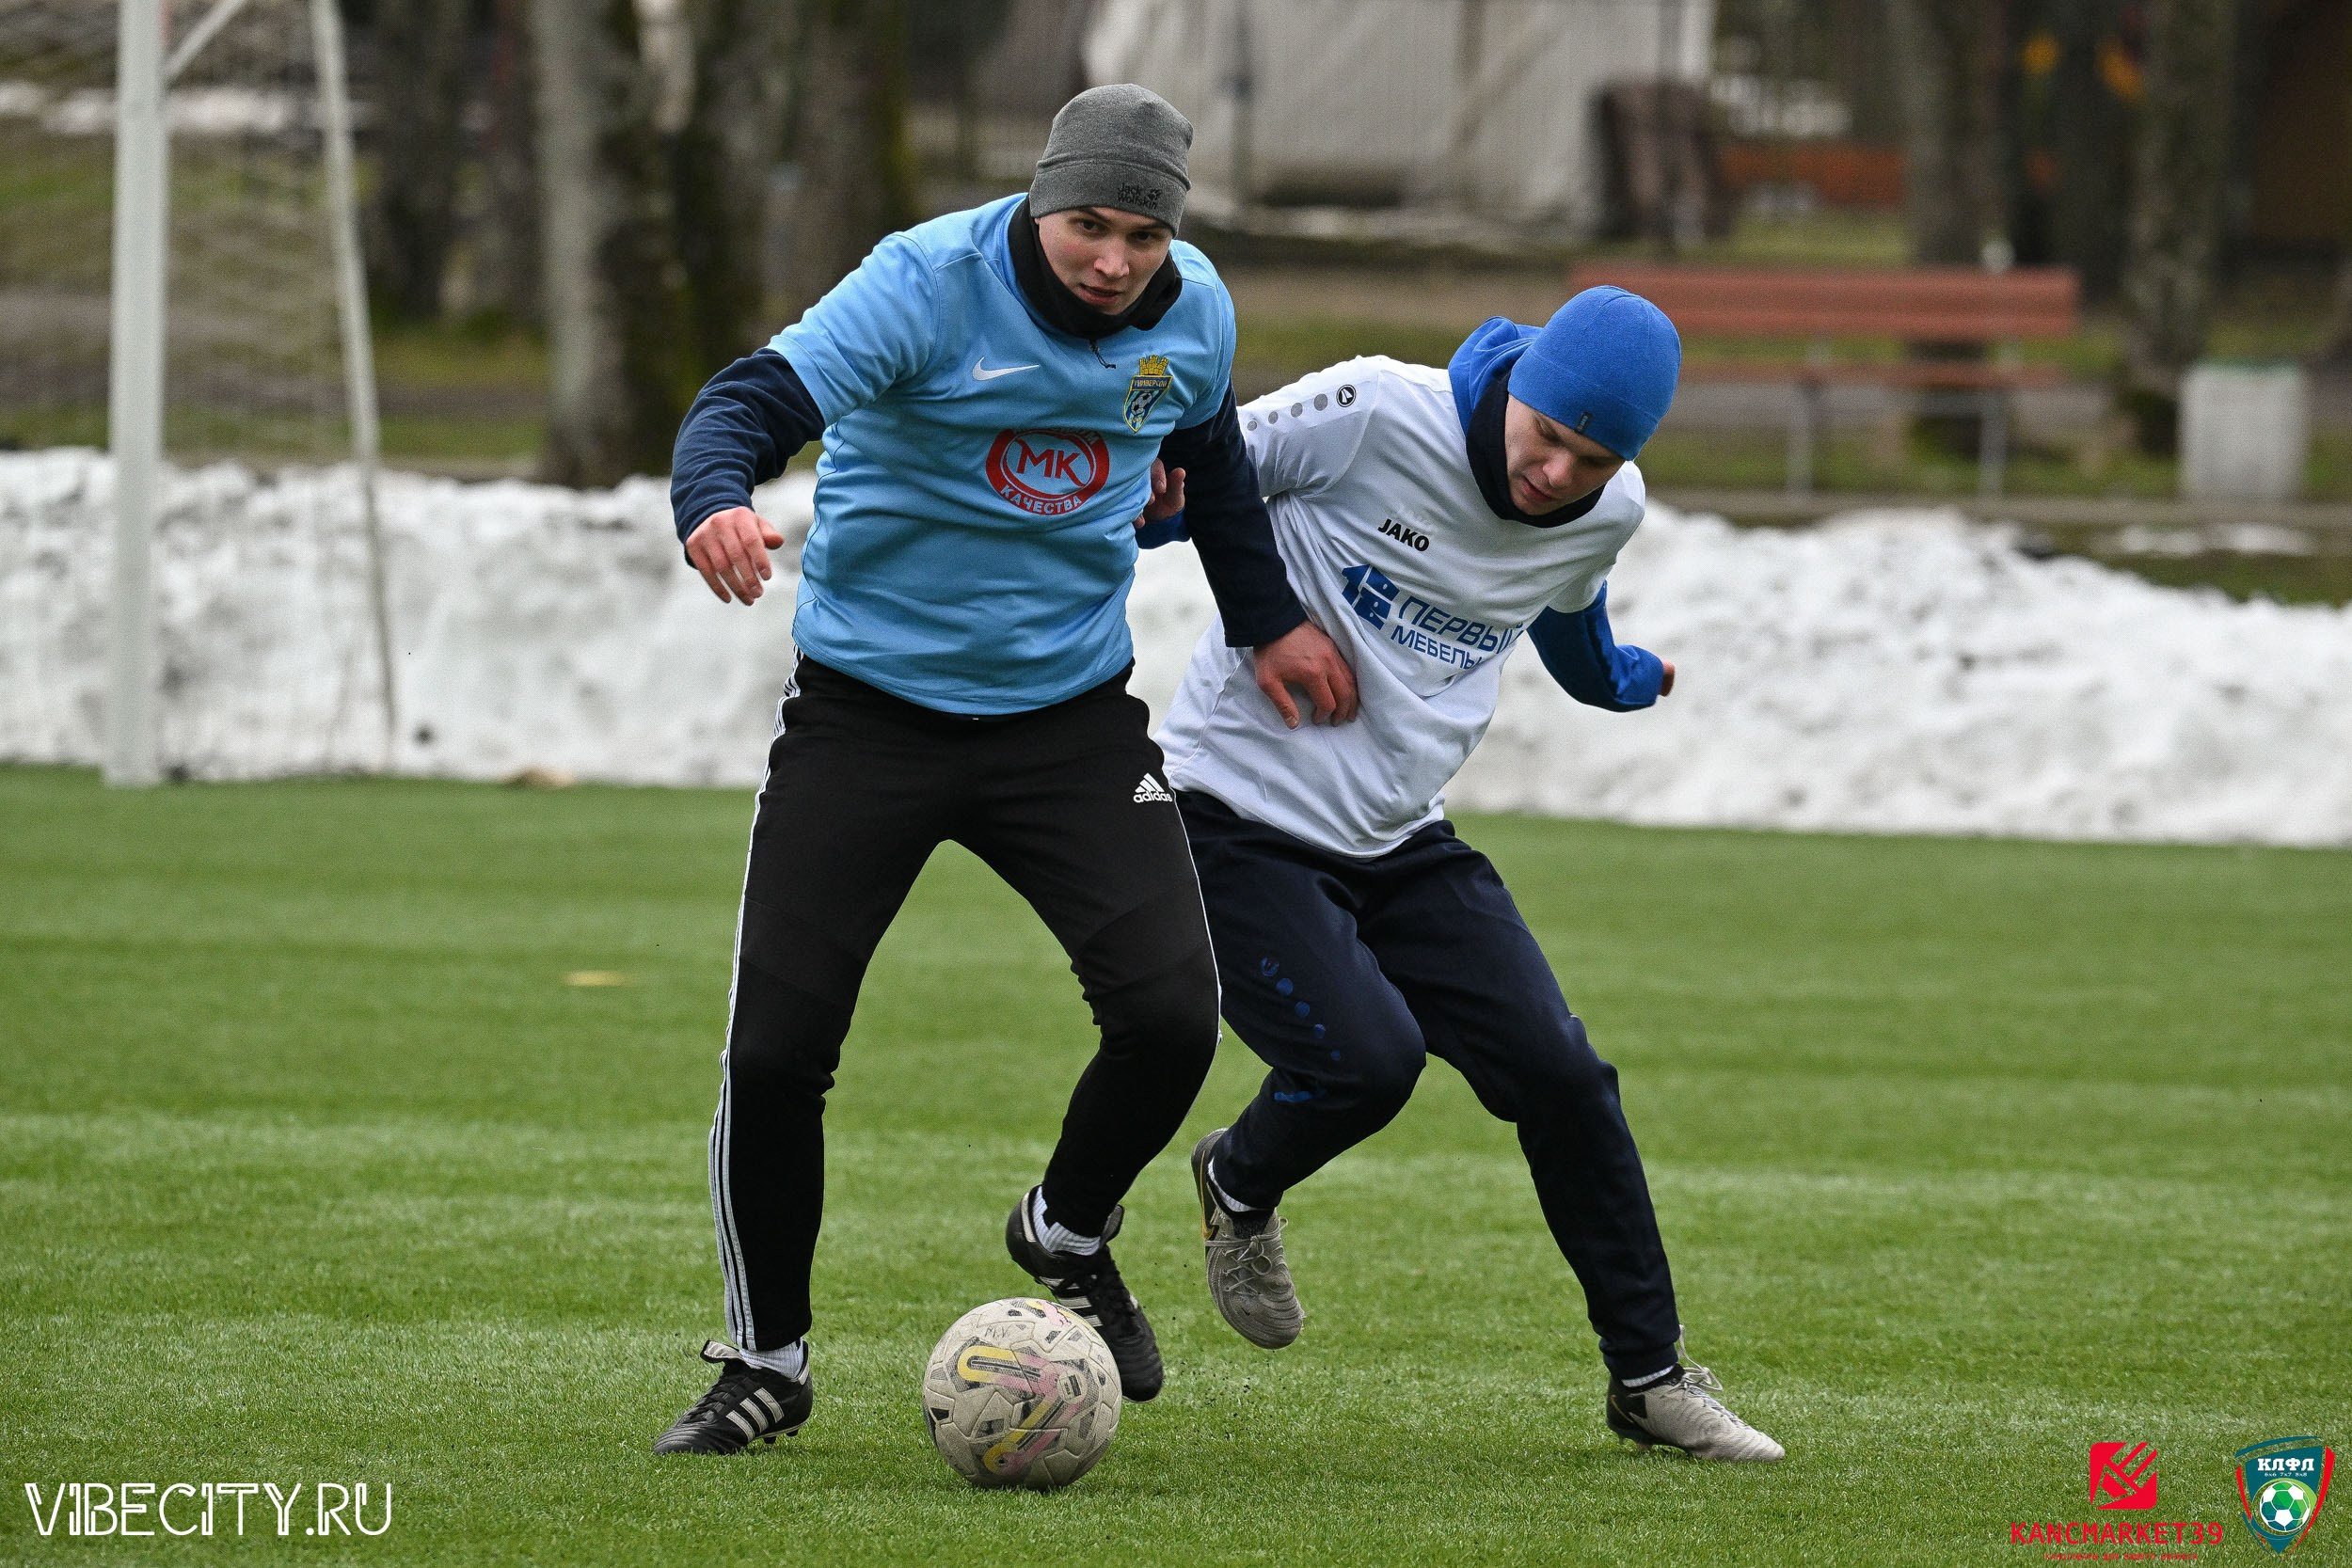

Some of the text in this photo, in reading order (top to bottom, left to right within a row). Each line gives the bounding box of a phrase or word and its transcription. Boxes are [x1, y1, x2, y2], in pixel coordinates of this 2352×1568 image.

[1118, 182, 1142, 195] Jack
[1117, 192, 1157, 210] Wolfskin
[1000, 484, 1082, 515] КАЧЕСТВА
[1377, 518, 1430, 552] JAKO
[1133, 790, 1173, 803] adidas
